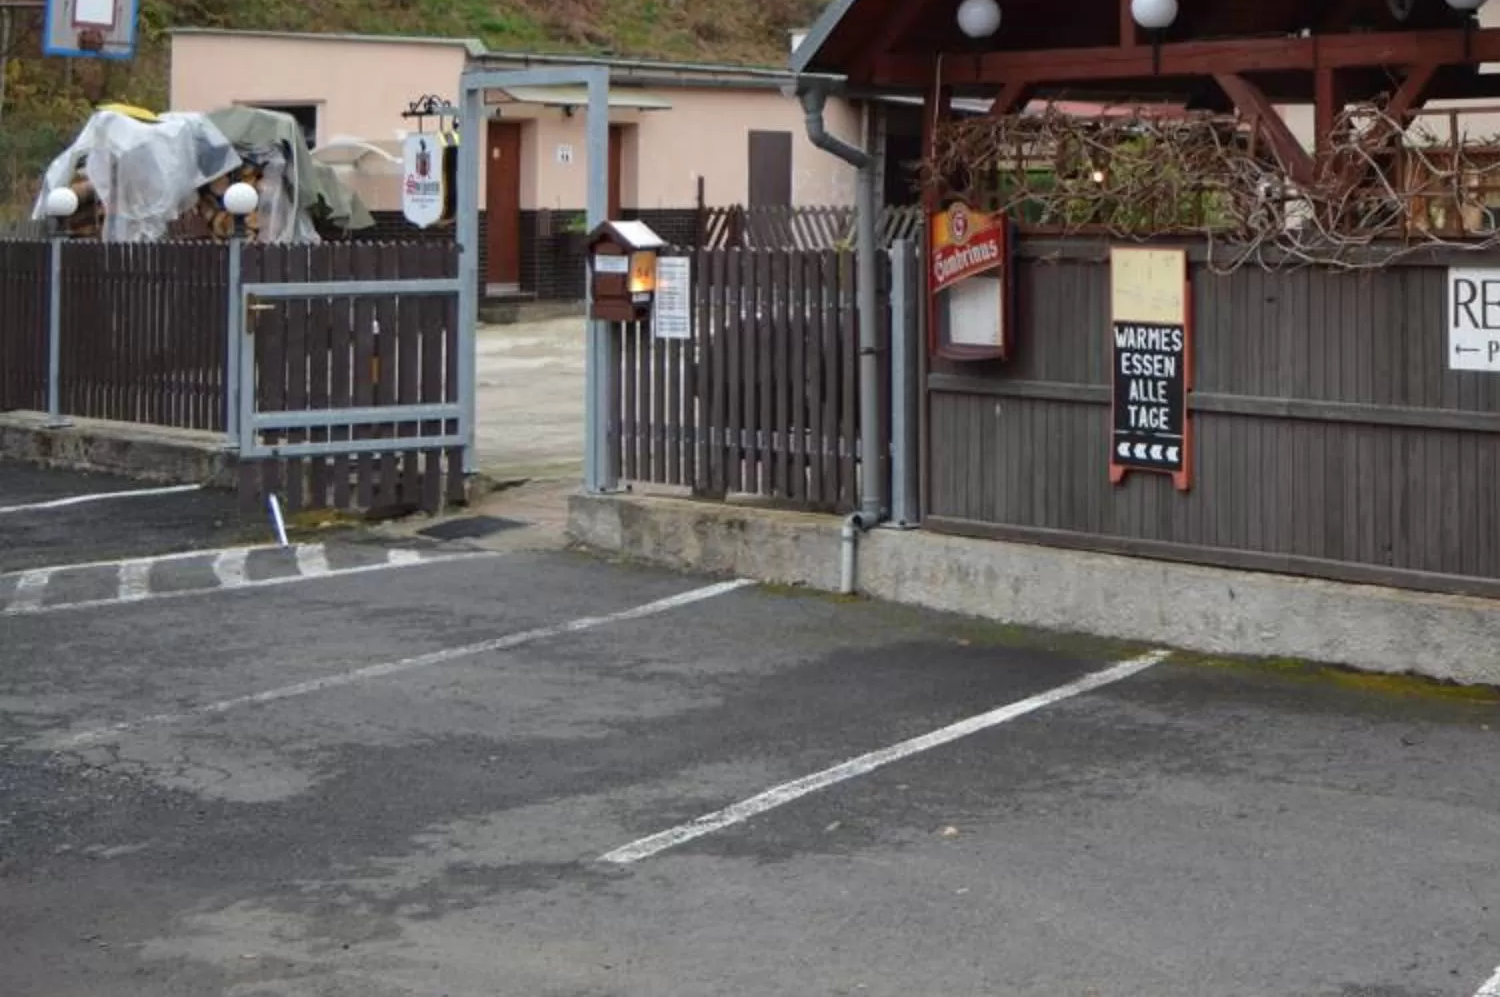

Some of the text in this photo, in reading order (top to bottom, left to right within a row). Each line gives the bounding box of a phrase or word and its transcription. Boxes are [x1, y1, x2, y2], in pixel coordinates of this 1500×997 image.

[1114, 325, 1183, 352] WARMES
[1120, 352, 1176, 378] ESSEN
[1128, 378, 1169, 404] ALLE
[1127, 404, 1170, 431] TAGE
